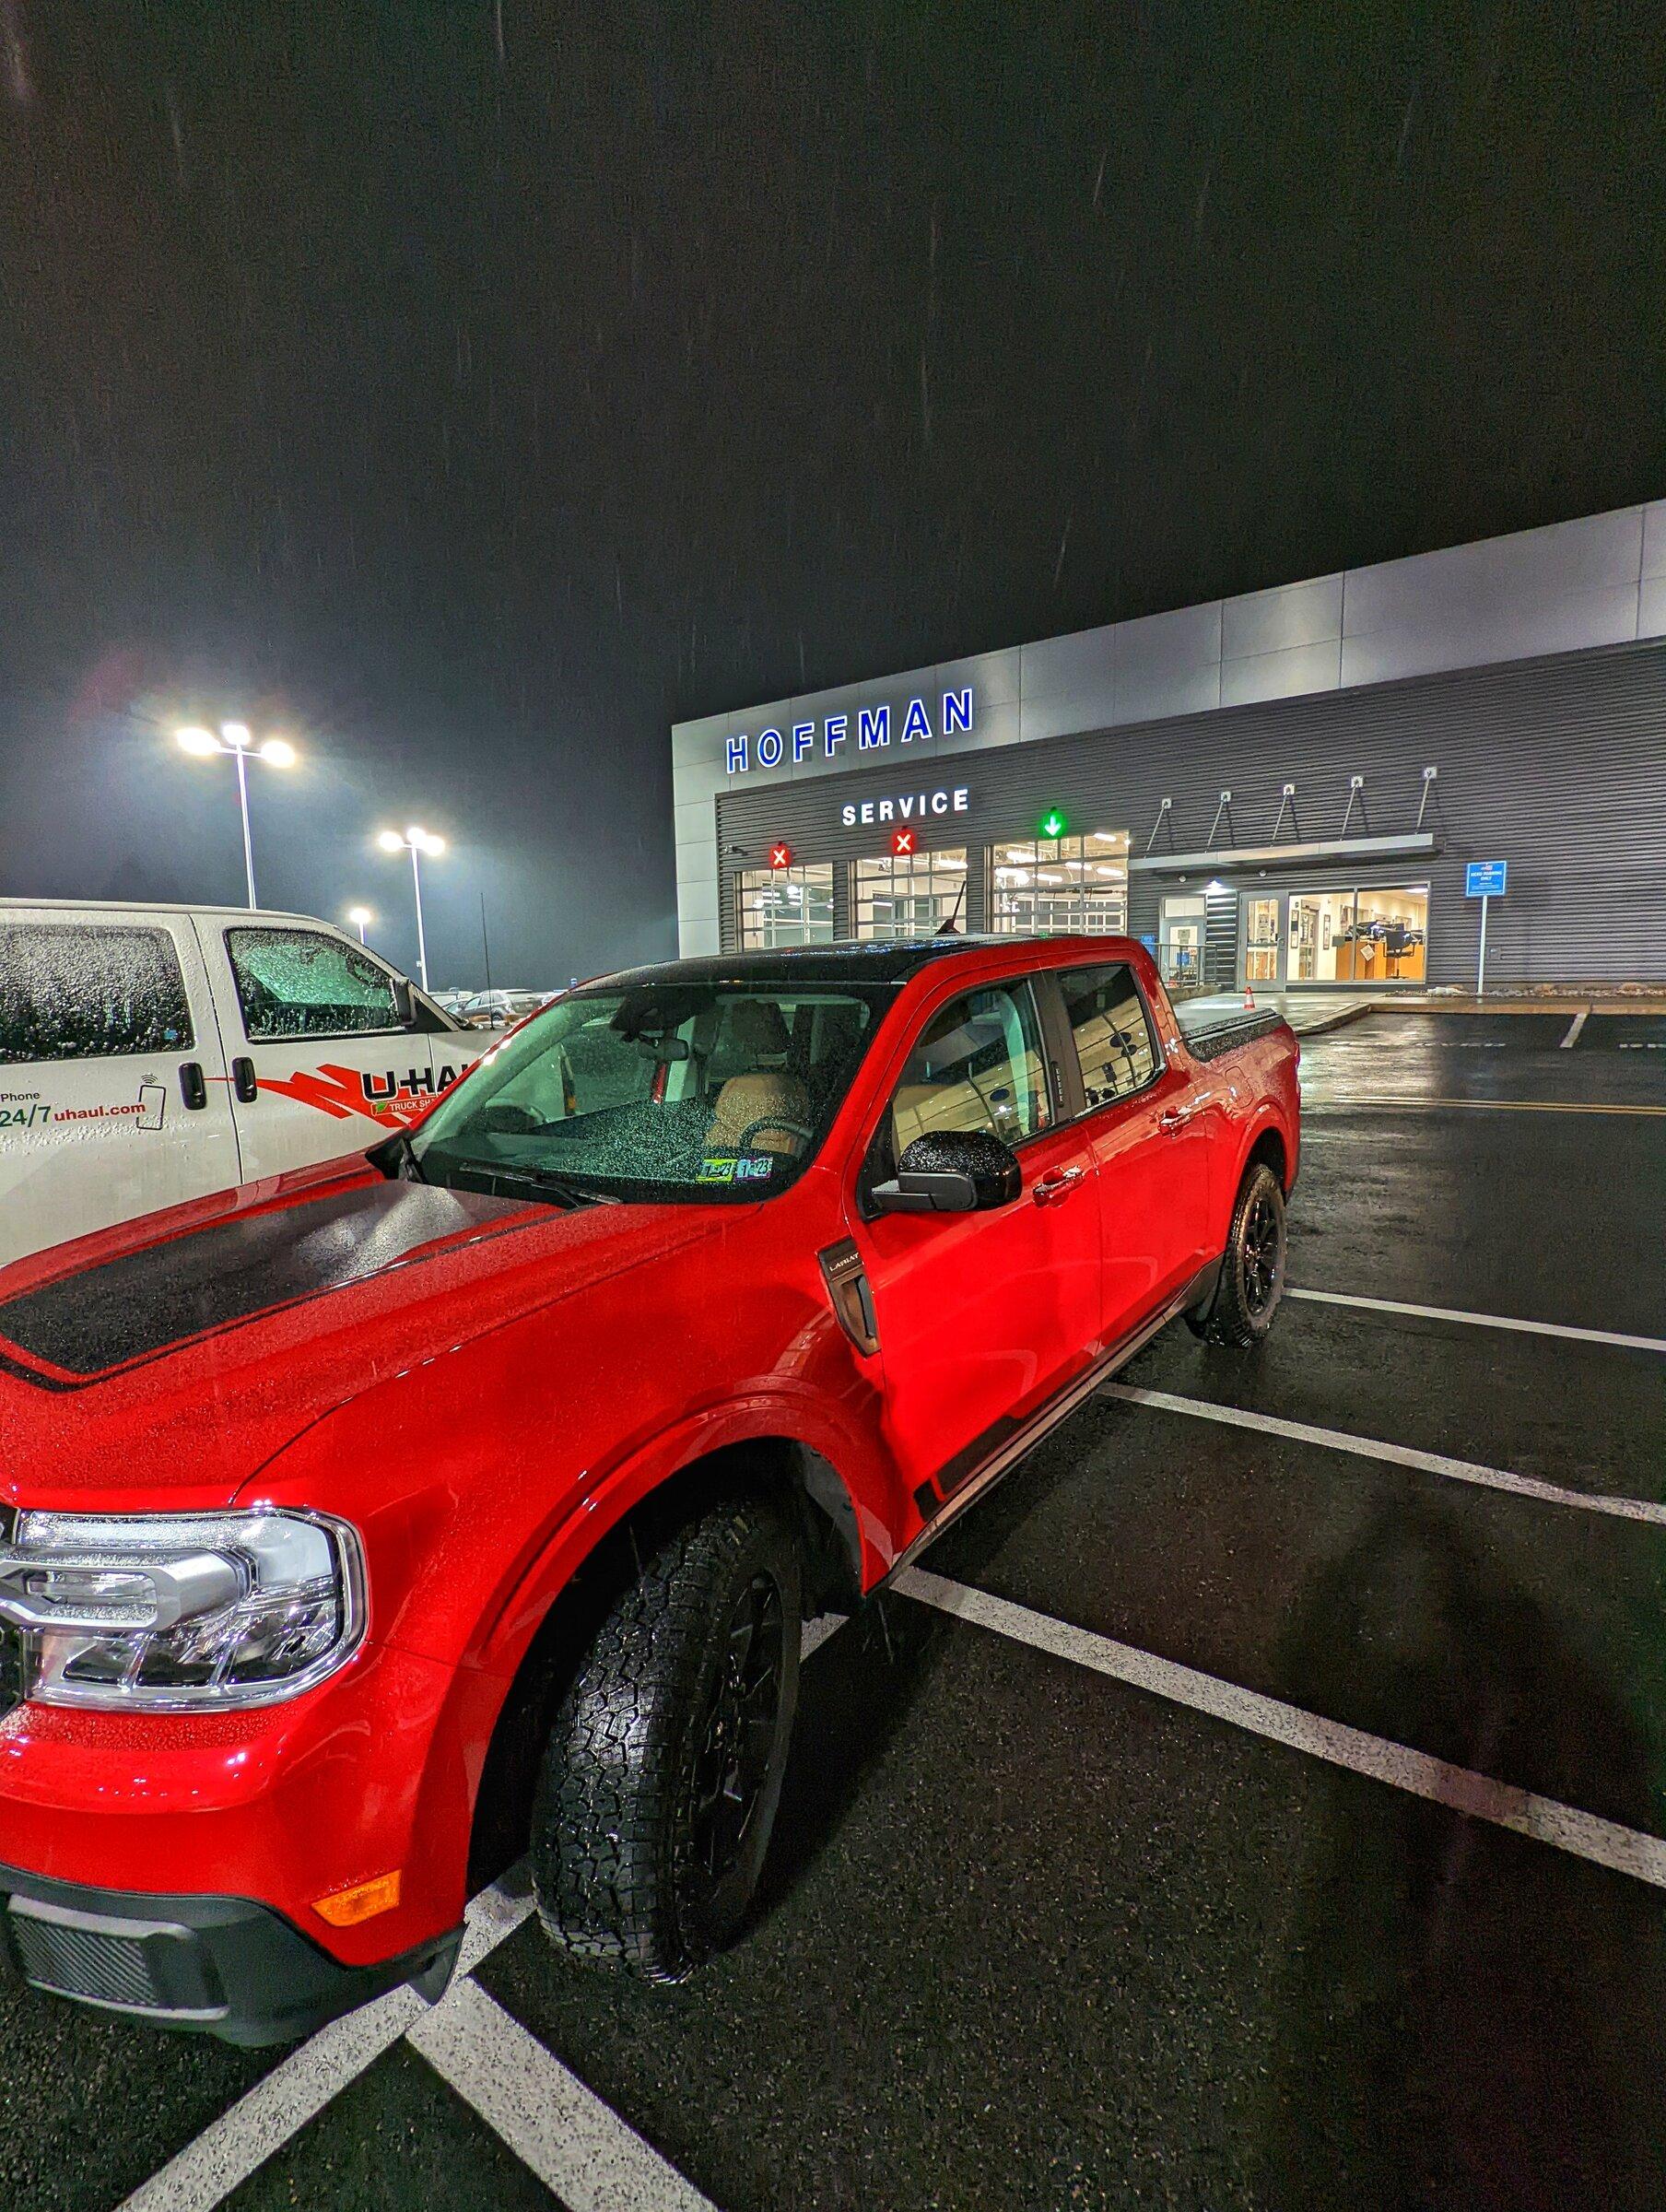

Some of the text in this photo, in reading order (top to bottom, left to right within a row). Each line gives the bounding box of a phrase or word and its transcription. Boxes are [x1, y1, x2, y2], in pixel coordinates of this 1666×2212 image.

[726, 688, 973, 774] HOFFMAN
[842, 789, 968, 826] SERVICE
[362, 1064, 468, 1100] U-HA
[1, 1092, 41, 1102] Phone
[389, 1100, 418, 1112] TRUCK
[0, 1103, 147, 1127] 24/7 uhaul.com
[829, 1252, 860, 1272] LARIAT
